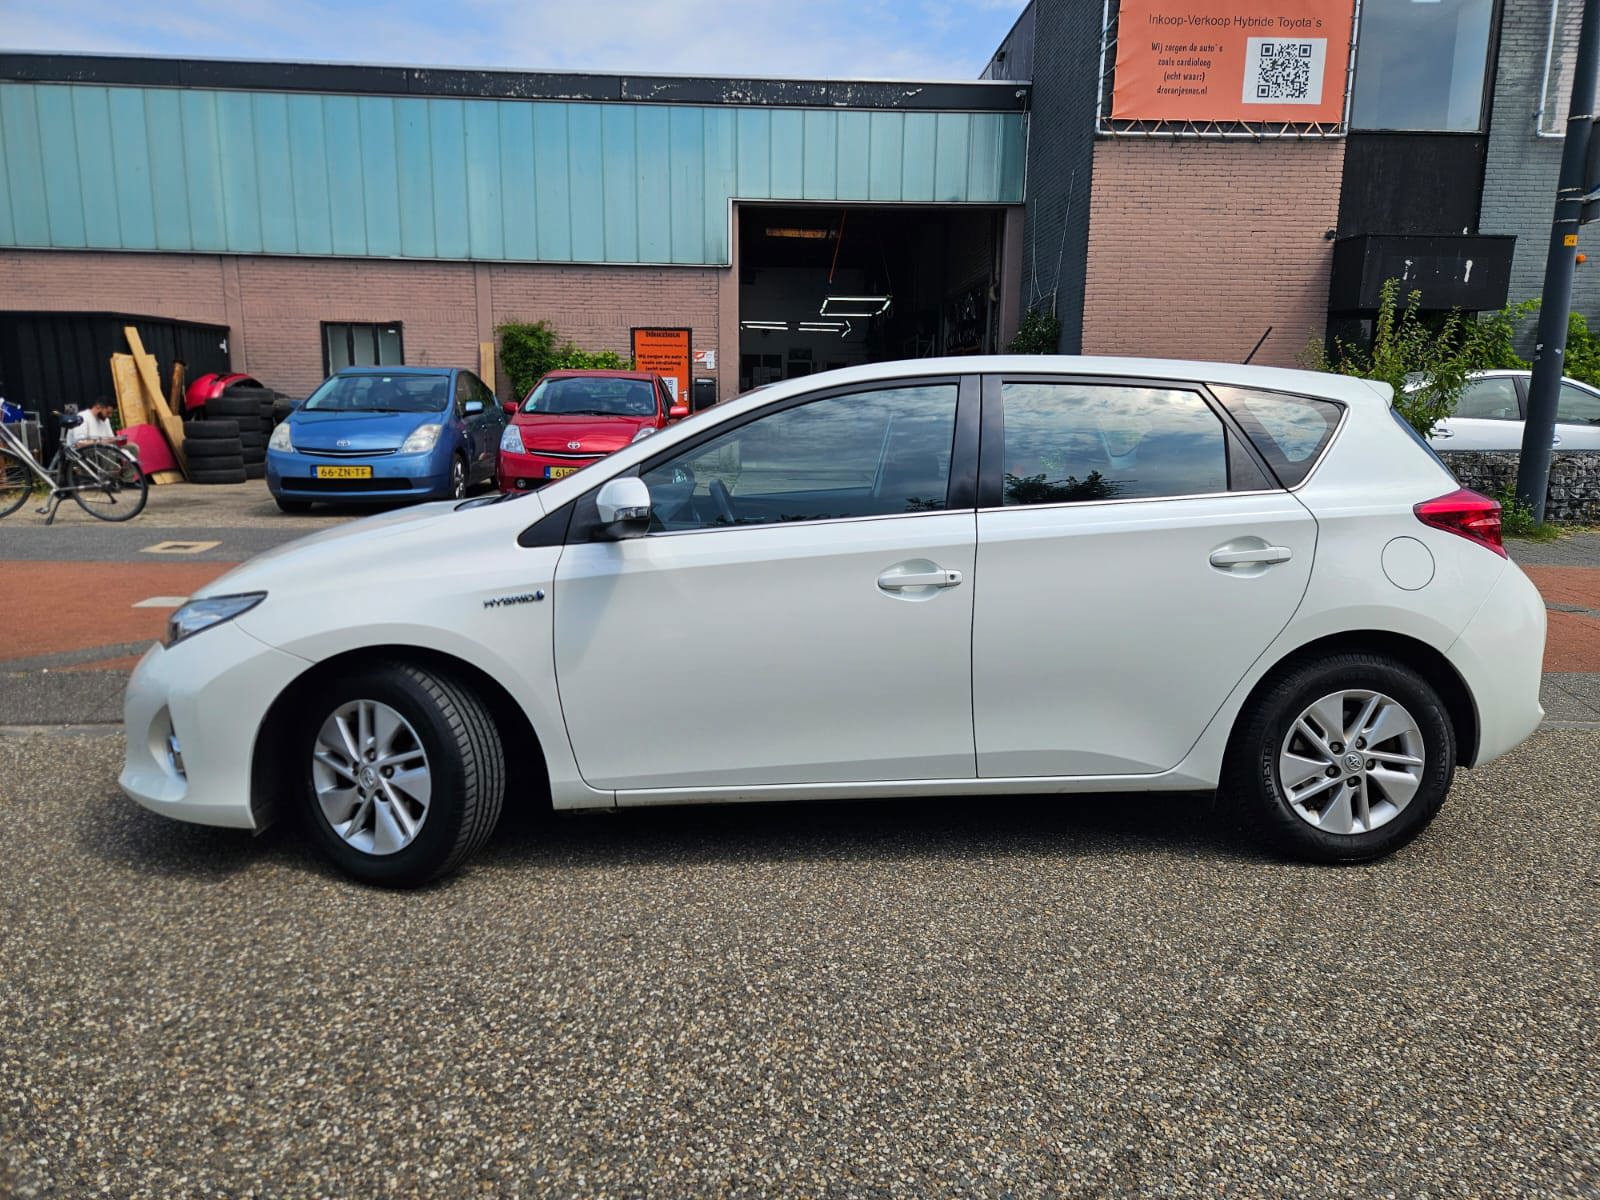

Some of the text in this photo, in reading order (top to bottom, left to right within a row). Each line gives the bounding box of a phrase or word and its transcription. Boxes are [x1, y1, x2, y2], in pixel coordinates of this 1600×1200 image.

[1149, 14, 1231, 28] Inkoop-Verkoop
[1233, 15, 1274, 28] Hybride
[1151, 42, 1163, 54] Wij
[321, 467, 369, 477] 66-ZN-TF
[483, 593, 535, 608] HYBRID
